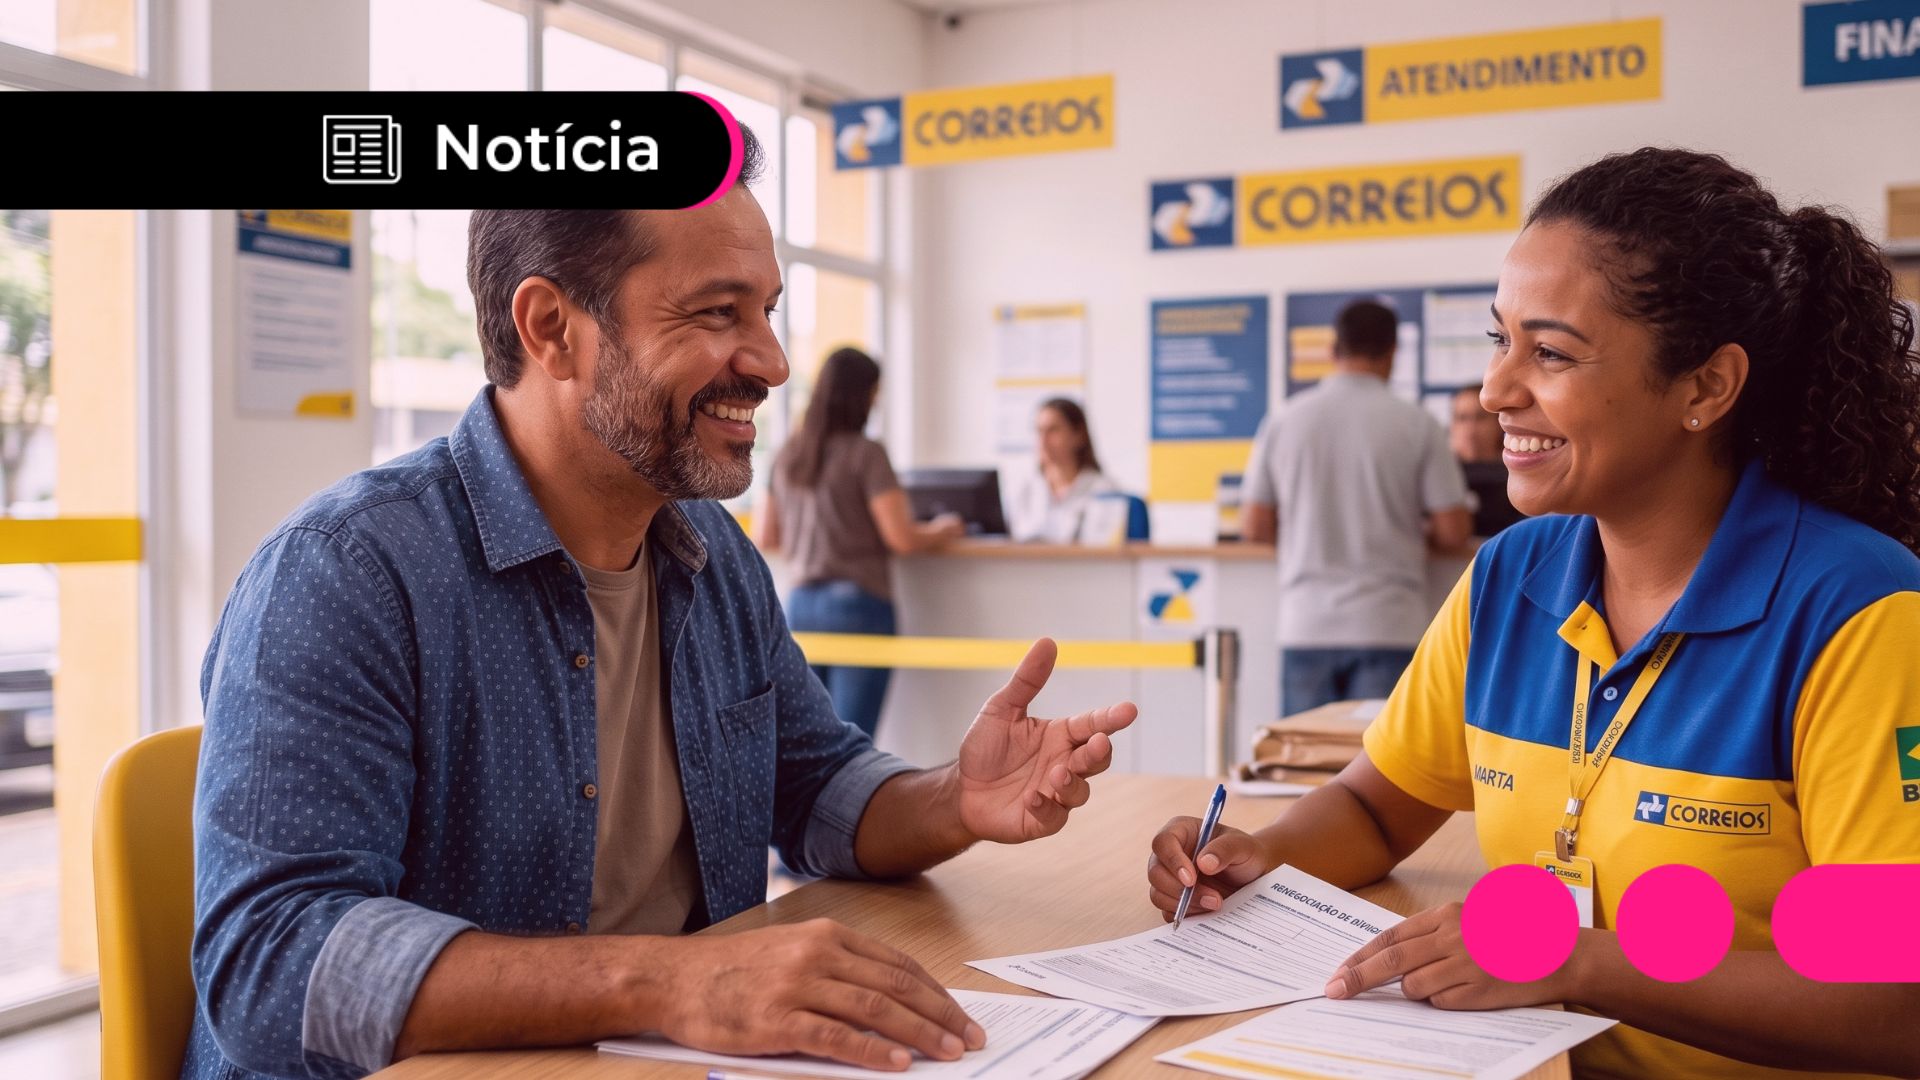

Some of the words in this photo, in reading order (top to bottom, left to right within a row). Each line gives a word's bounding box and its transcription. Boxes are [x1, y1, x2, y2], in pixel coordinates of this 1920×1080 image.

[1379, 43, 1647, 98] ATENDIMENTO
[913, 96, 1103, 147] CORREIOS
[1251, 170, 1507, 231] CORREIOS
[1474, 763, 1514, 791] MARTA
[1670, 804, 1765, 829] CORREIOS
[1270, 882, 1339, 916] RENEGOCIAÇÃO
[1336, 912, 1353, 922] DE
